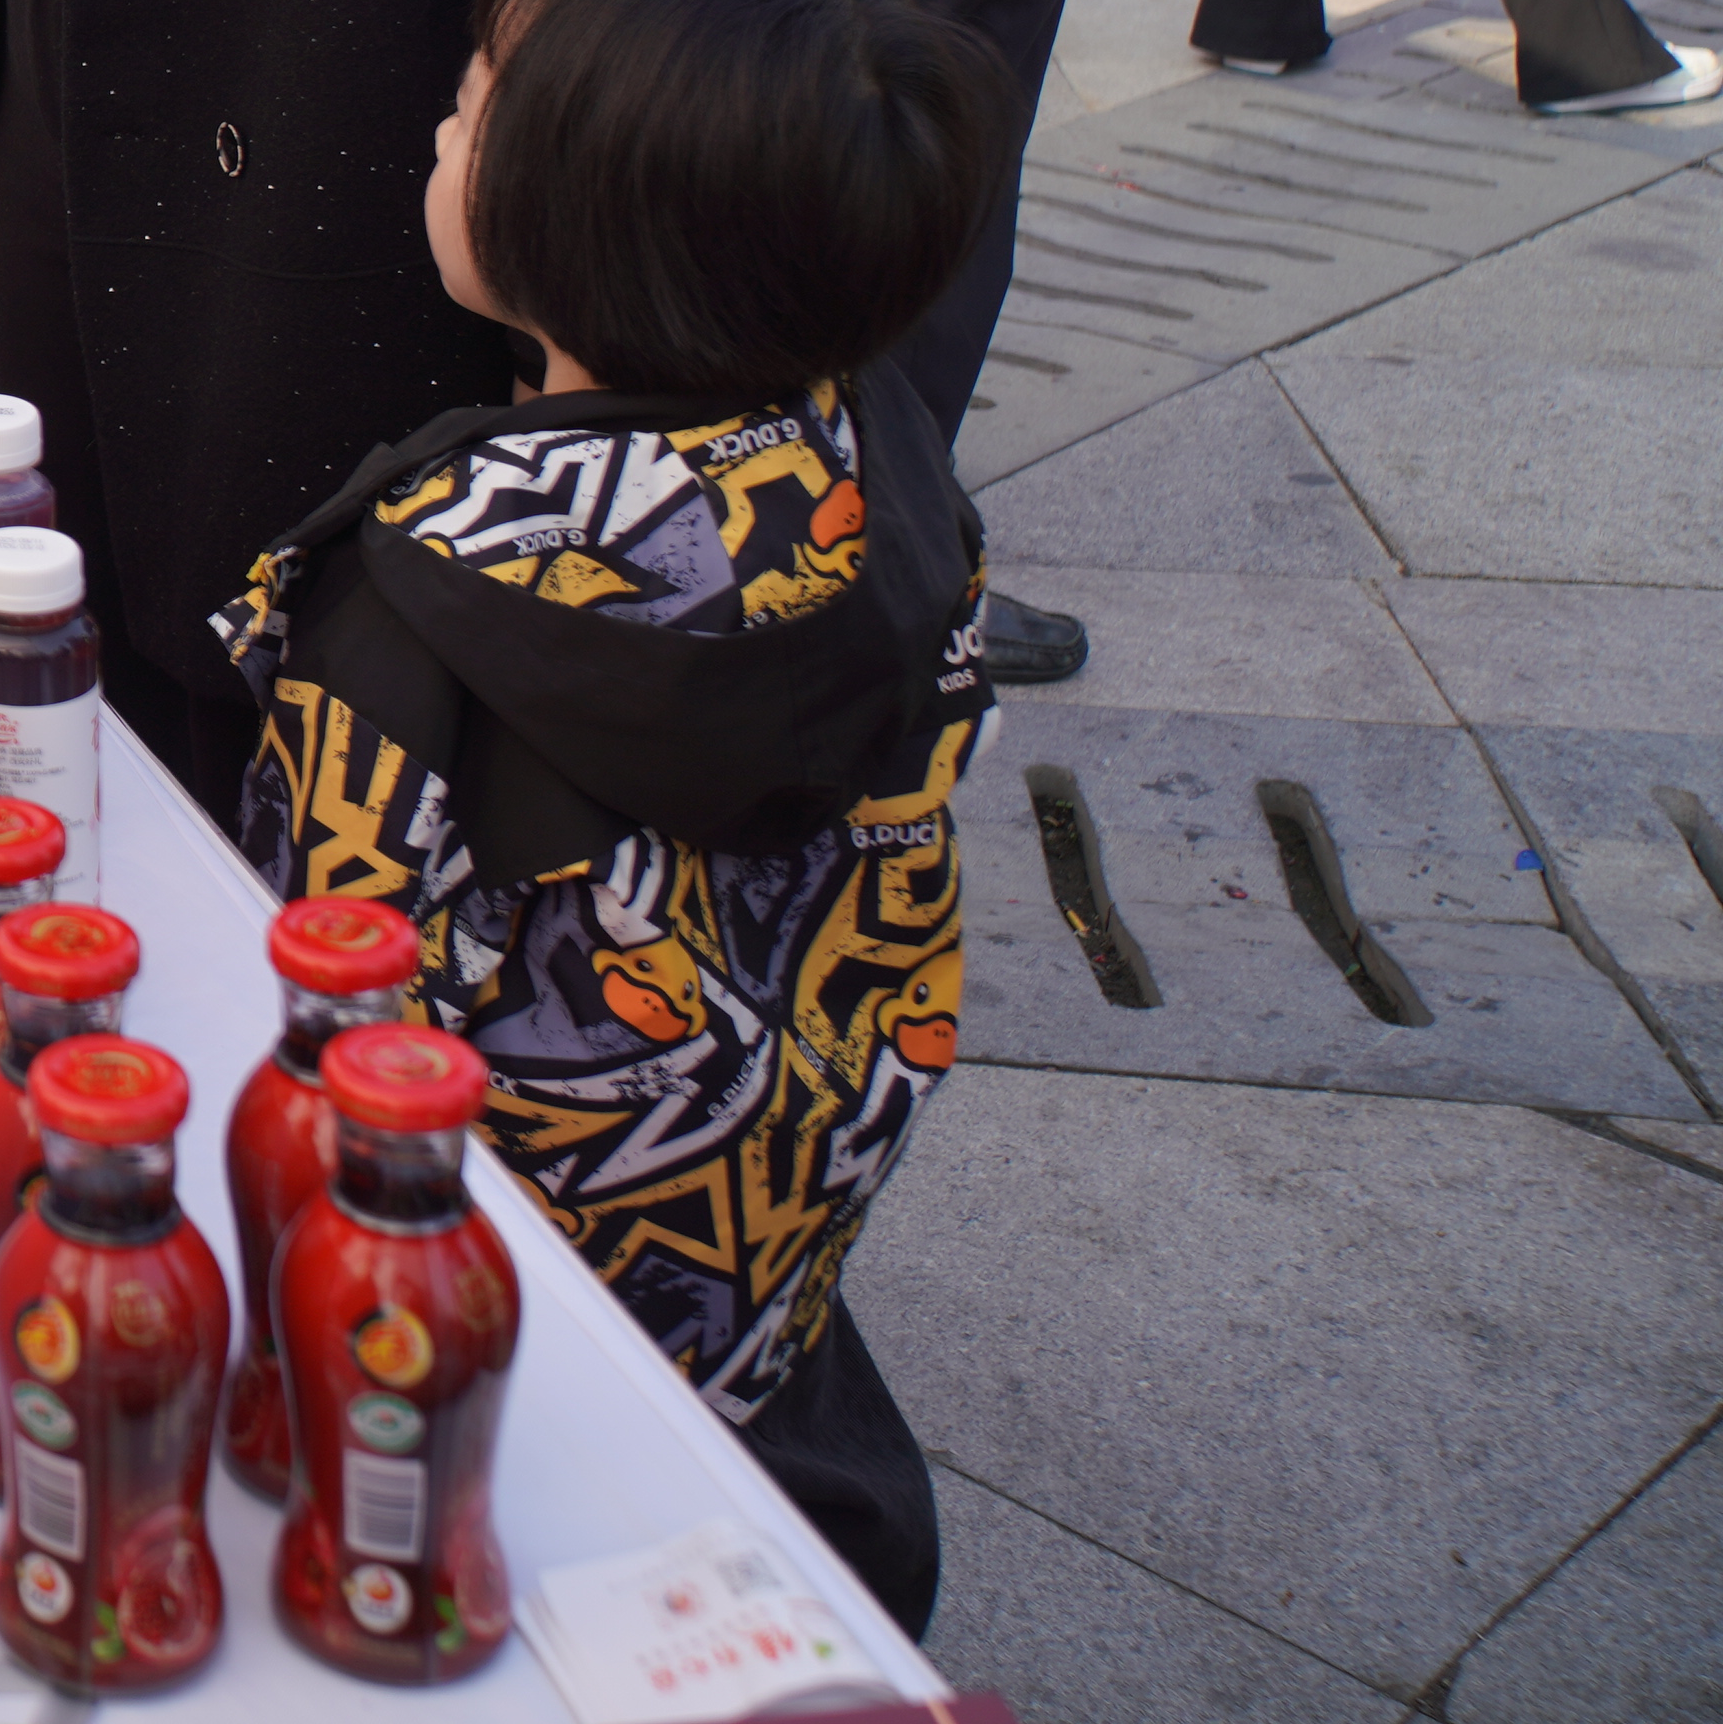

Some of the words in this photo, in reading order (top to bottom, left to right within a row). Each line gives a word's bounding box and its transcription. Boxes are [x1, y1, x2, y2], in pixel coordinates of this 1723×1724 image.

[516, 528, 588, 557] G.DUCK
[936, 667, 977, 695] KIDS
[849, 822, 937, 850] G.DUC
[795, 1034, 830, 1073] KIDS
